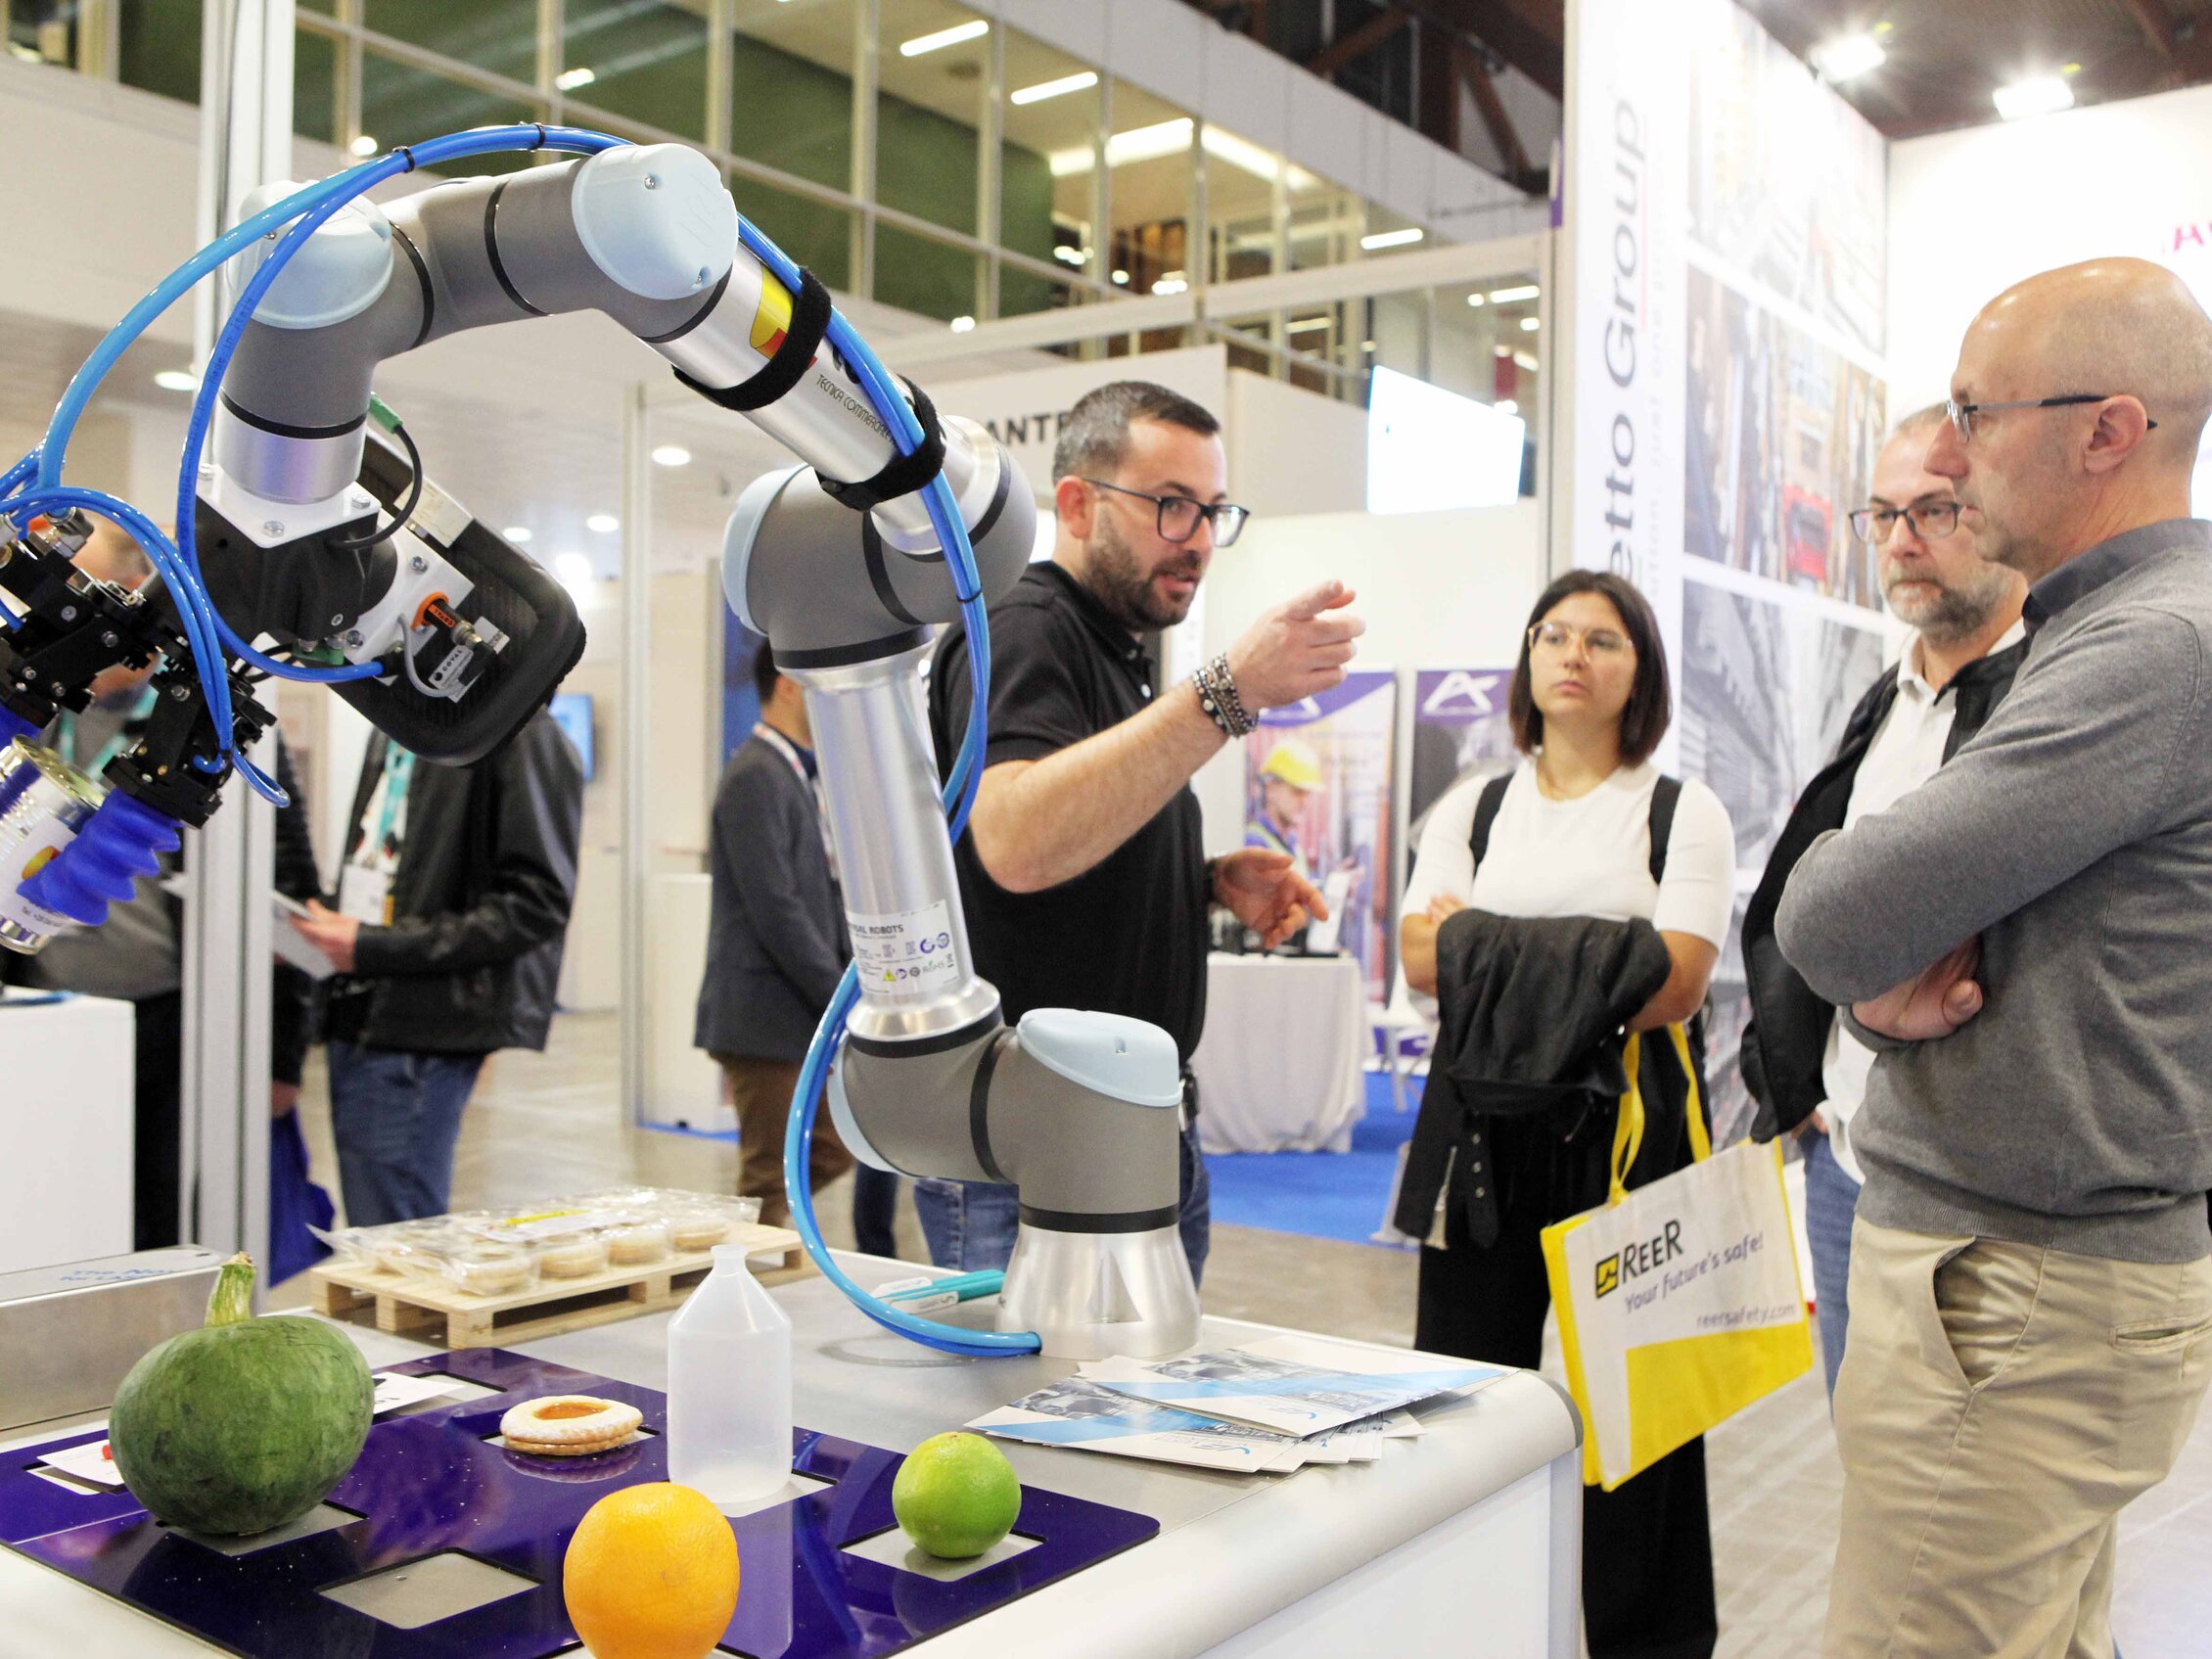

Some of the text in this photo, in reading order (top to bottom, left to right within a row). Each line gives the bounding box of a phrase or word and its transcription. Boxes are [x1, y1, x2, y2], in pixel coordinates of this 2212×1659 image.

[1604, 99, 1646, 584] etto Group
[815, 374, 845, 402] TECNICA
[442, 649, 463, 671] COVAL
[869, 924, 904, 935] ROBOTS
[1624, 1230, 1764, 1314] Your future's safe!
